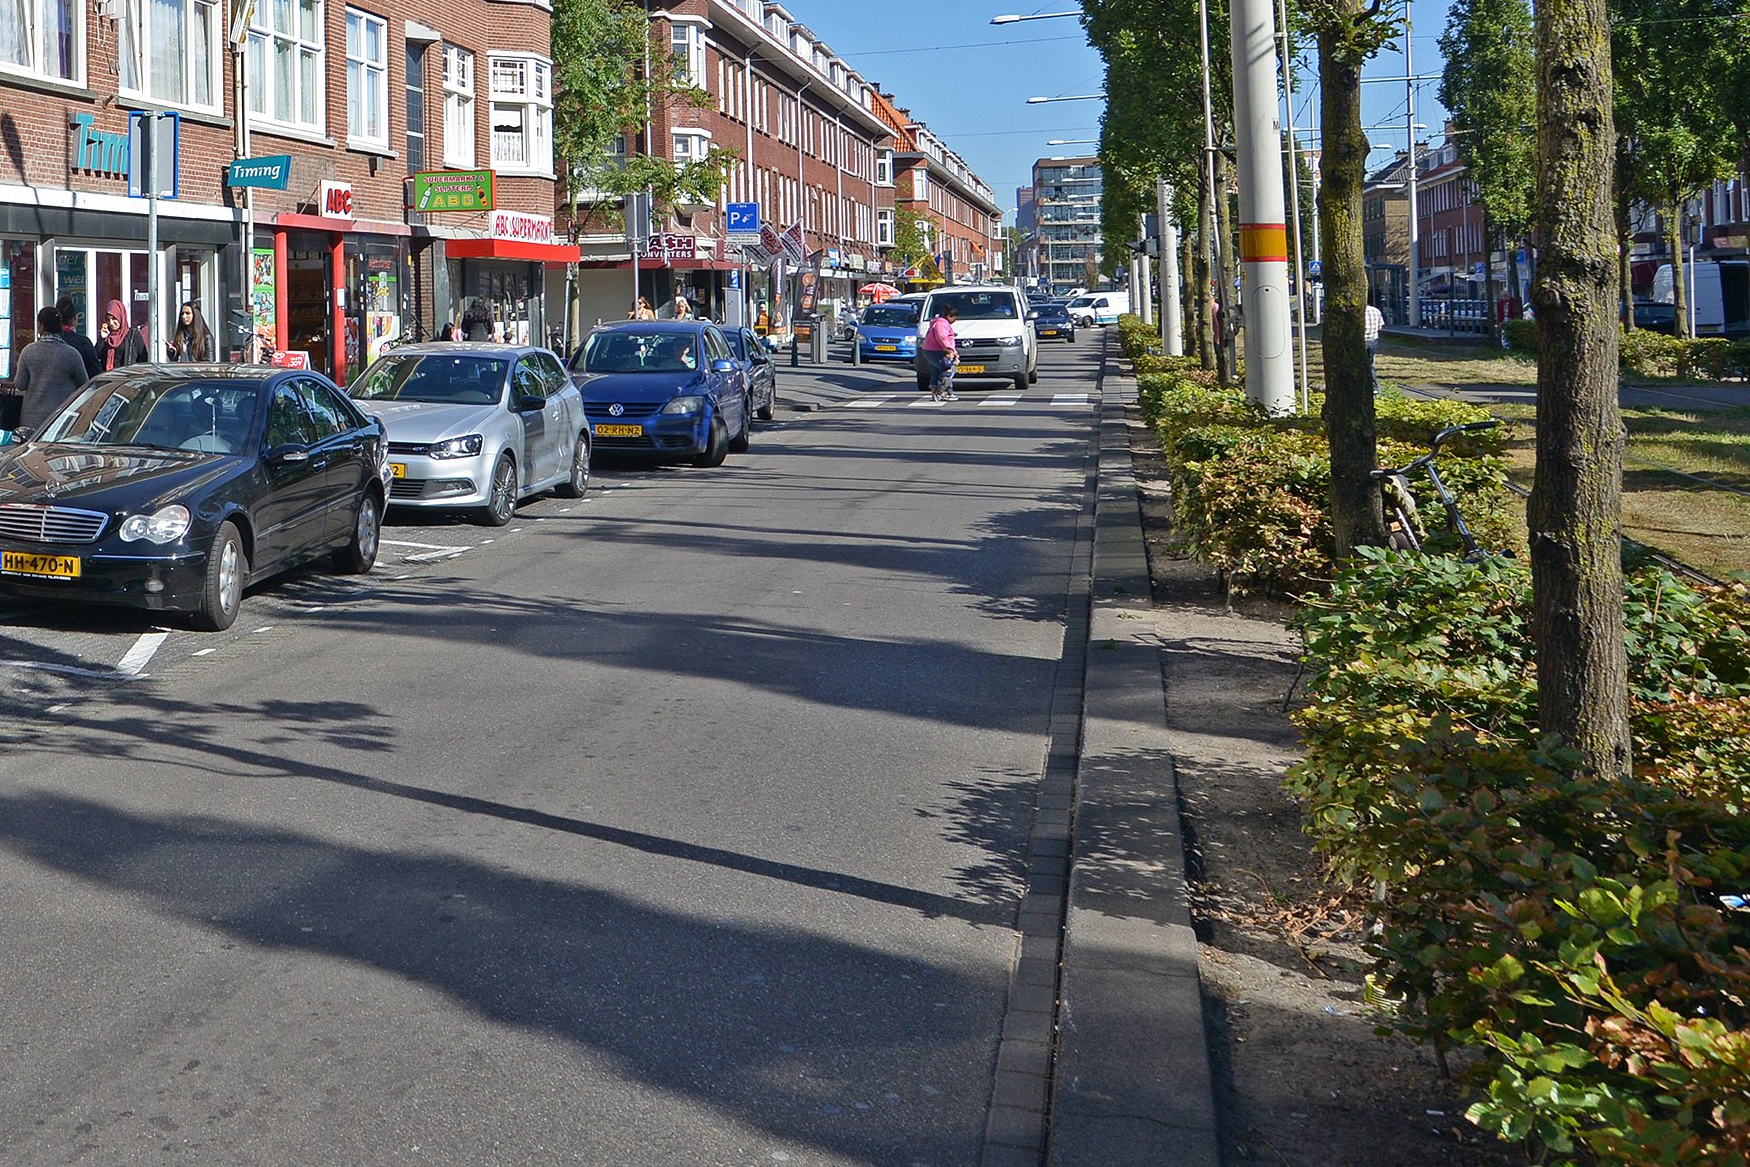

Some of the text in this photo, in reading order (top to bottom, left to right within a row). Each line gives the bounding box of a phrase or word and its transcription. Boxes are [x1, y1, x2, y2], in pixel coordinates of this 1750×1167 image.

[233, 165, 281, 180] Timing
[423, 175, 477, 183] SUPERMARKT
[326, 188, 352, 215] ABC
[730, 212, 740, 225] P
[495, 215, 552, 241] ABC SUPERMARKT
[3, 553, 74, 574] HH-470-N
